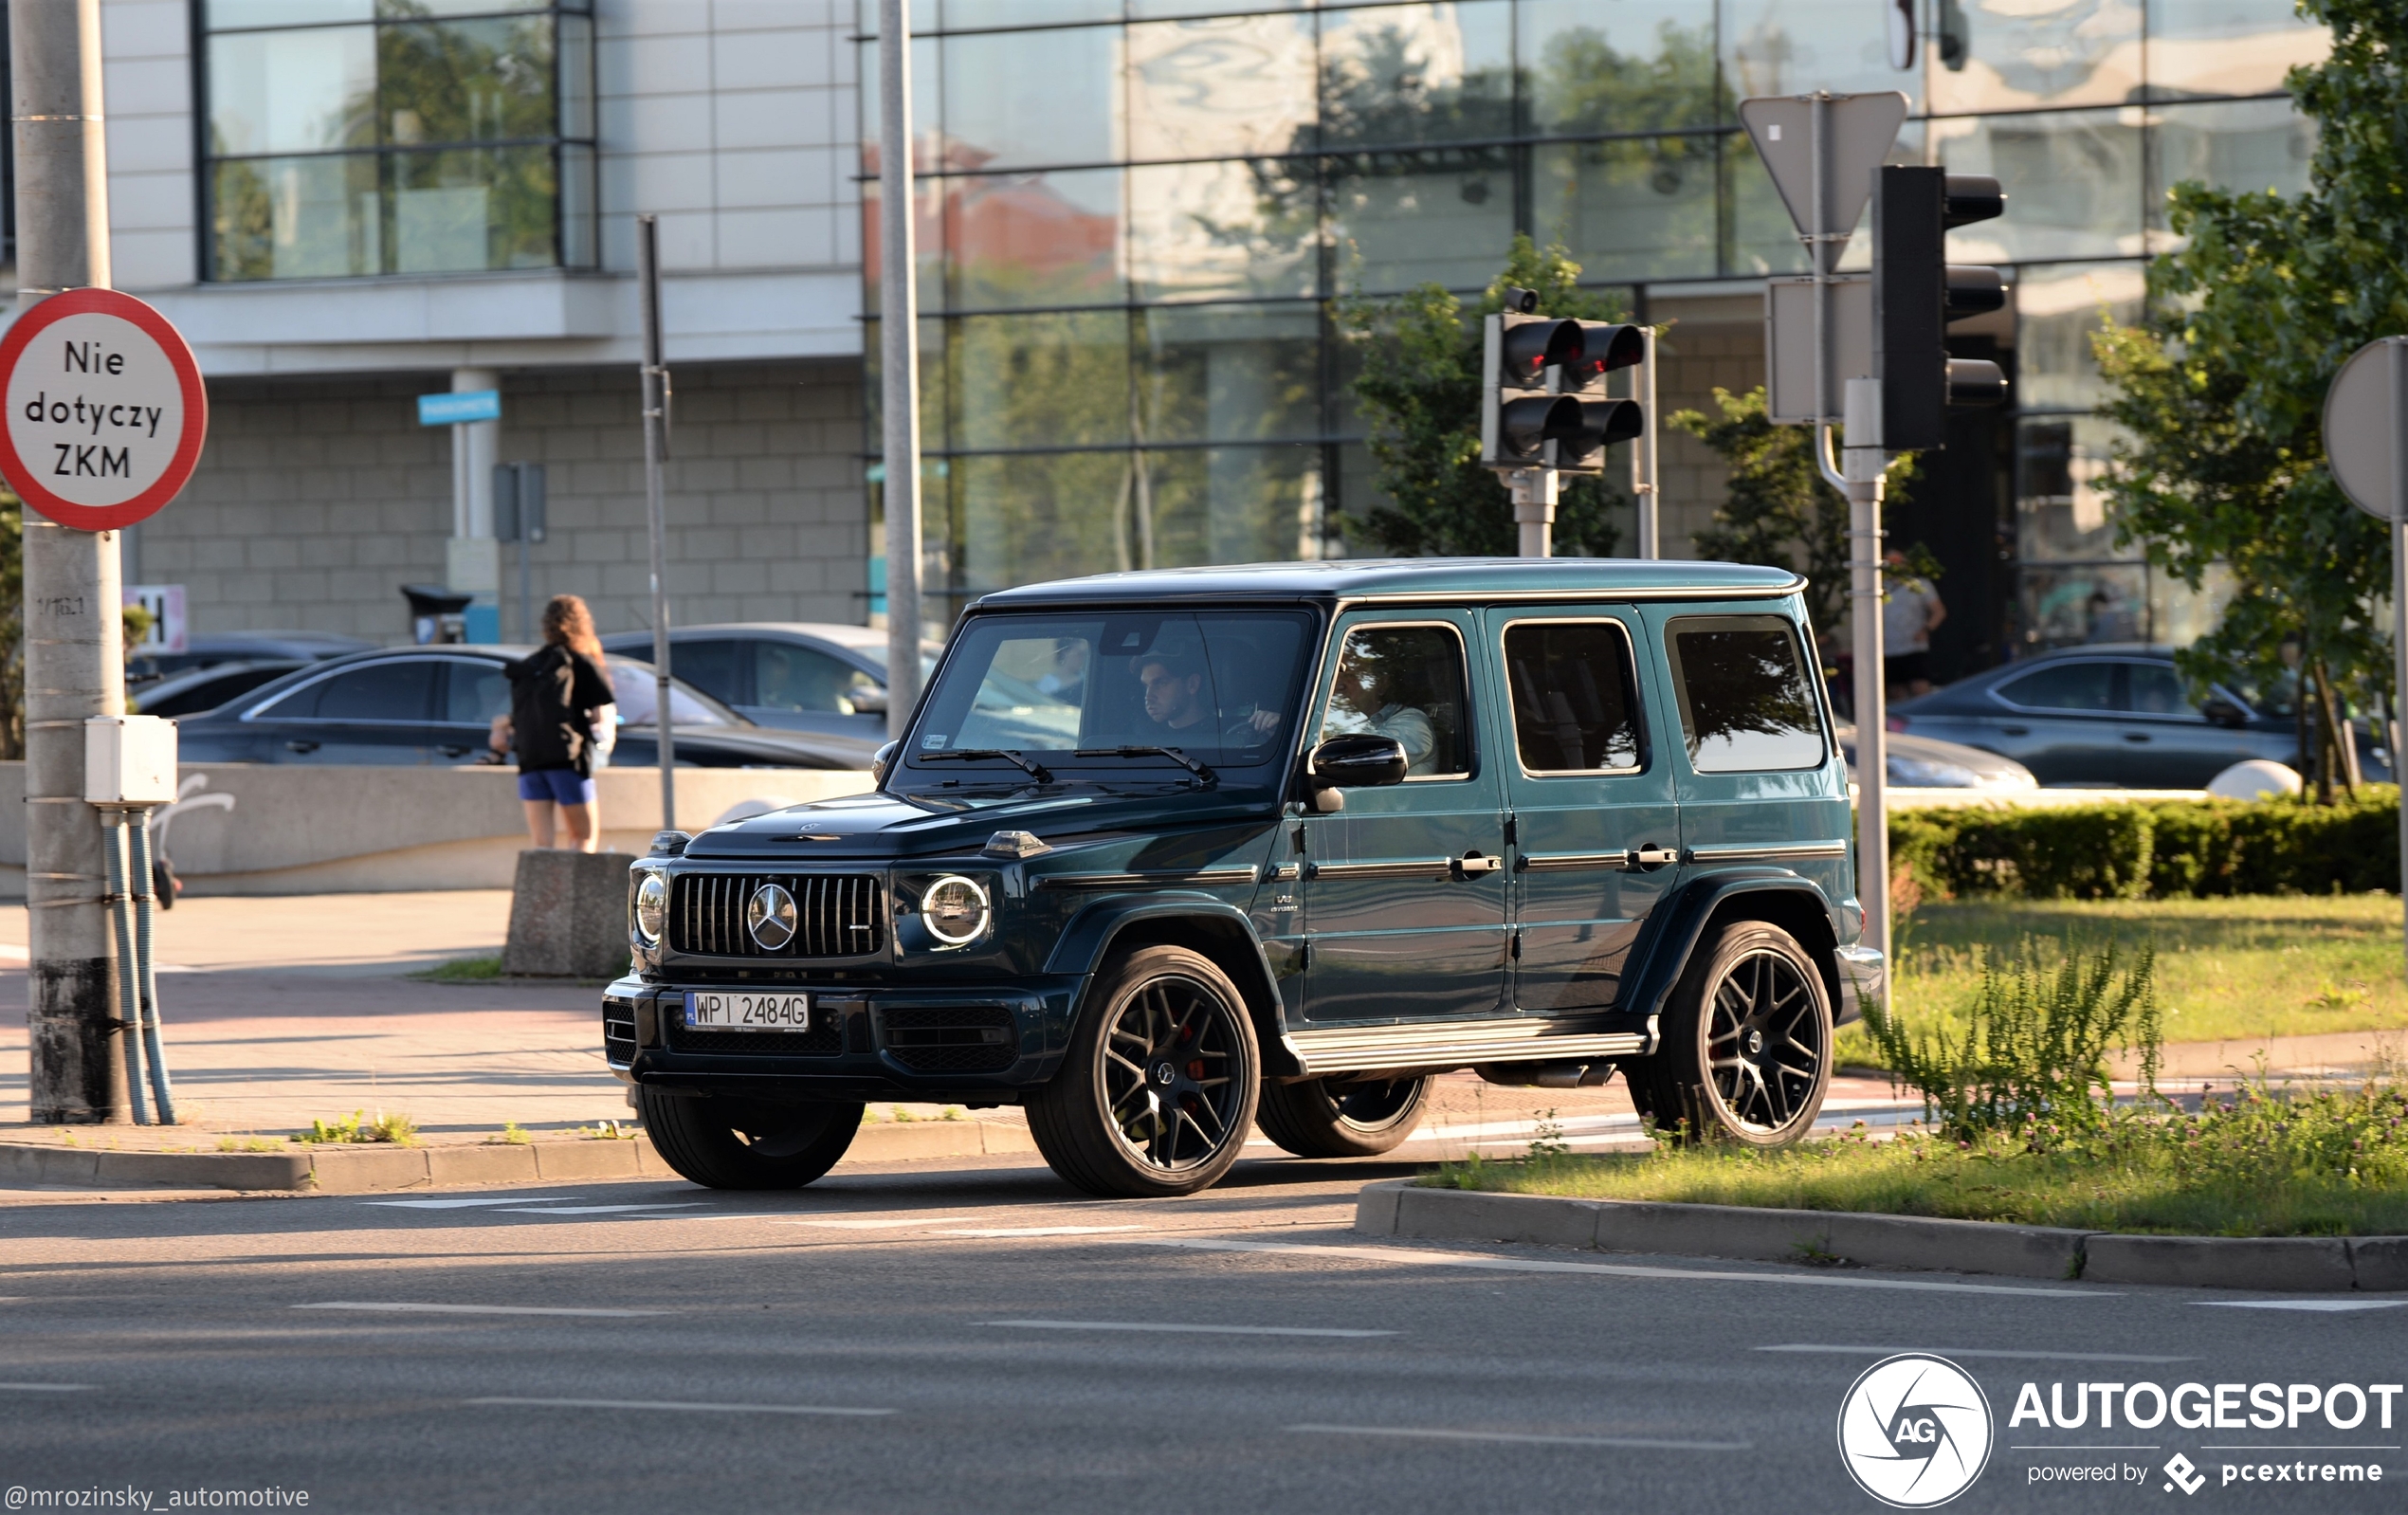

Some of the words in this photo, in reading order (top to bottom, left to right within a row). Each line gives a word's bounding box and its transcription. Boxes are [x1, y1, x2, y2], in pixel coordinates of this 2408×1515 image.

[64, 340, 124, 375] Nie
[25, 391, 162, 438] dotyczy
[53, 443, 131, 478] ZKM
[686, 1012, 695, 1021] PL
[696, 995, 731, 1023] WPI
[741, 996, 805, 1025] 2484G
